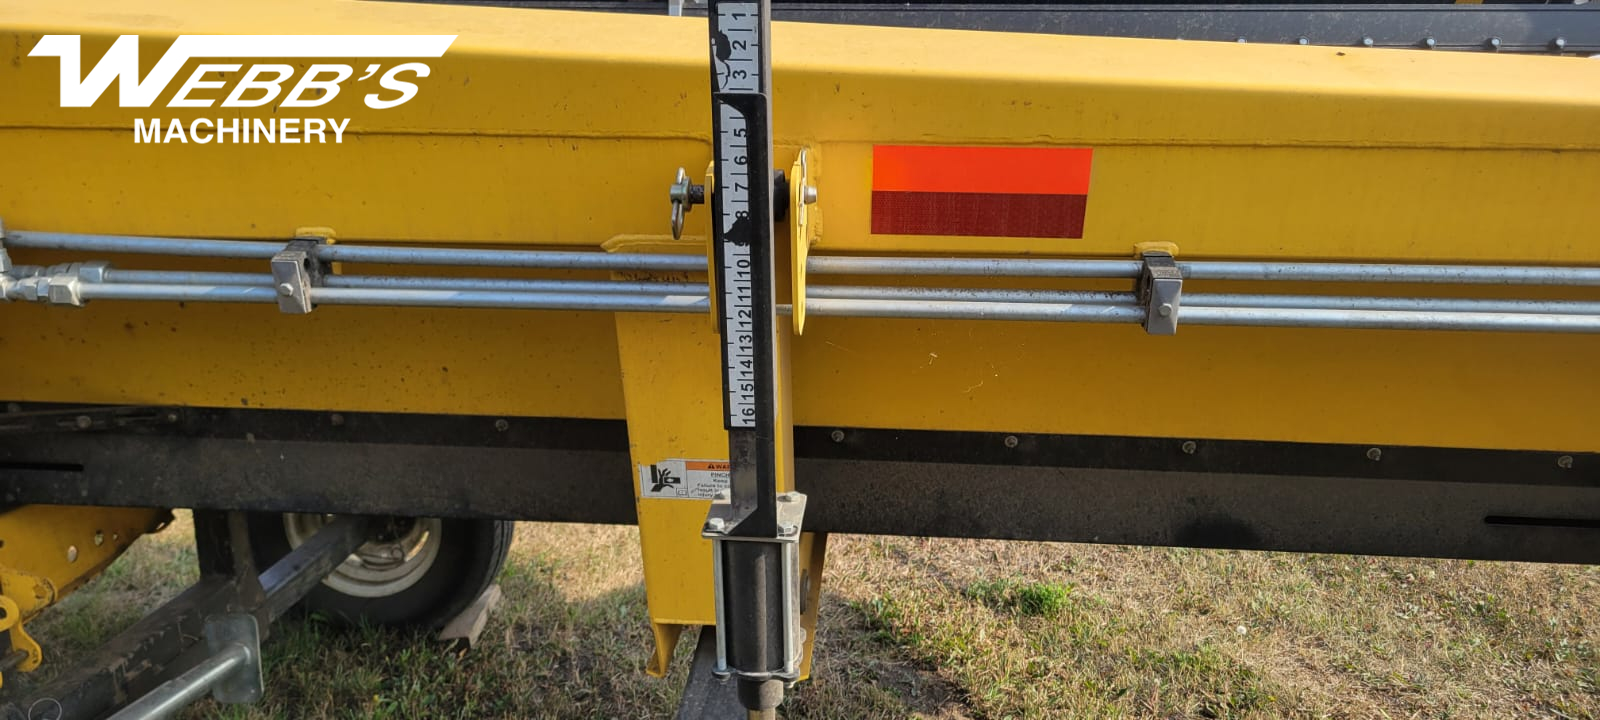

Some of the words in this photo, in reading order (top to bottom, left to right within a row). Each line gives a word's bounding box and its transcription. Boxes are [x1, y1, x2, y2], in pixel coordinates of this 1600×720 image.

[731, 12, 746, 21] 1
[732, 40, 747, 51] 2
[732, 69, 747, 80] 3
[733, 128, 748, 138] 5
[734, 155, 748, 165] 6
[734, 182, 749, 192] 7
[736, 259, 751, 278] 10
[736, 286, 751, 302] 11
[738, 309, 752, 328] 12
[739, 334, 753, 352] 13
[740, 359, 753, 377] 14
[741, 383, 754, 400] 15
[742, 408, 755, 425] 16
